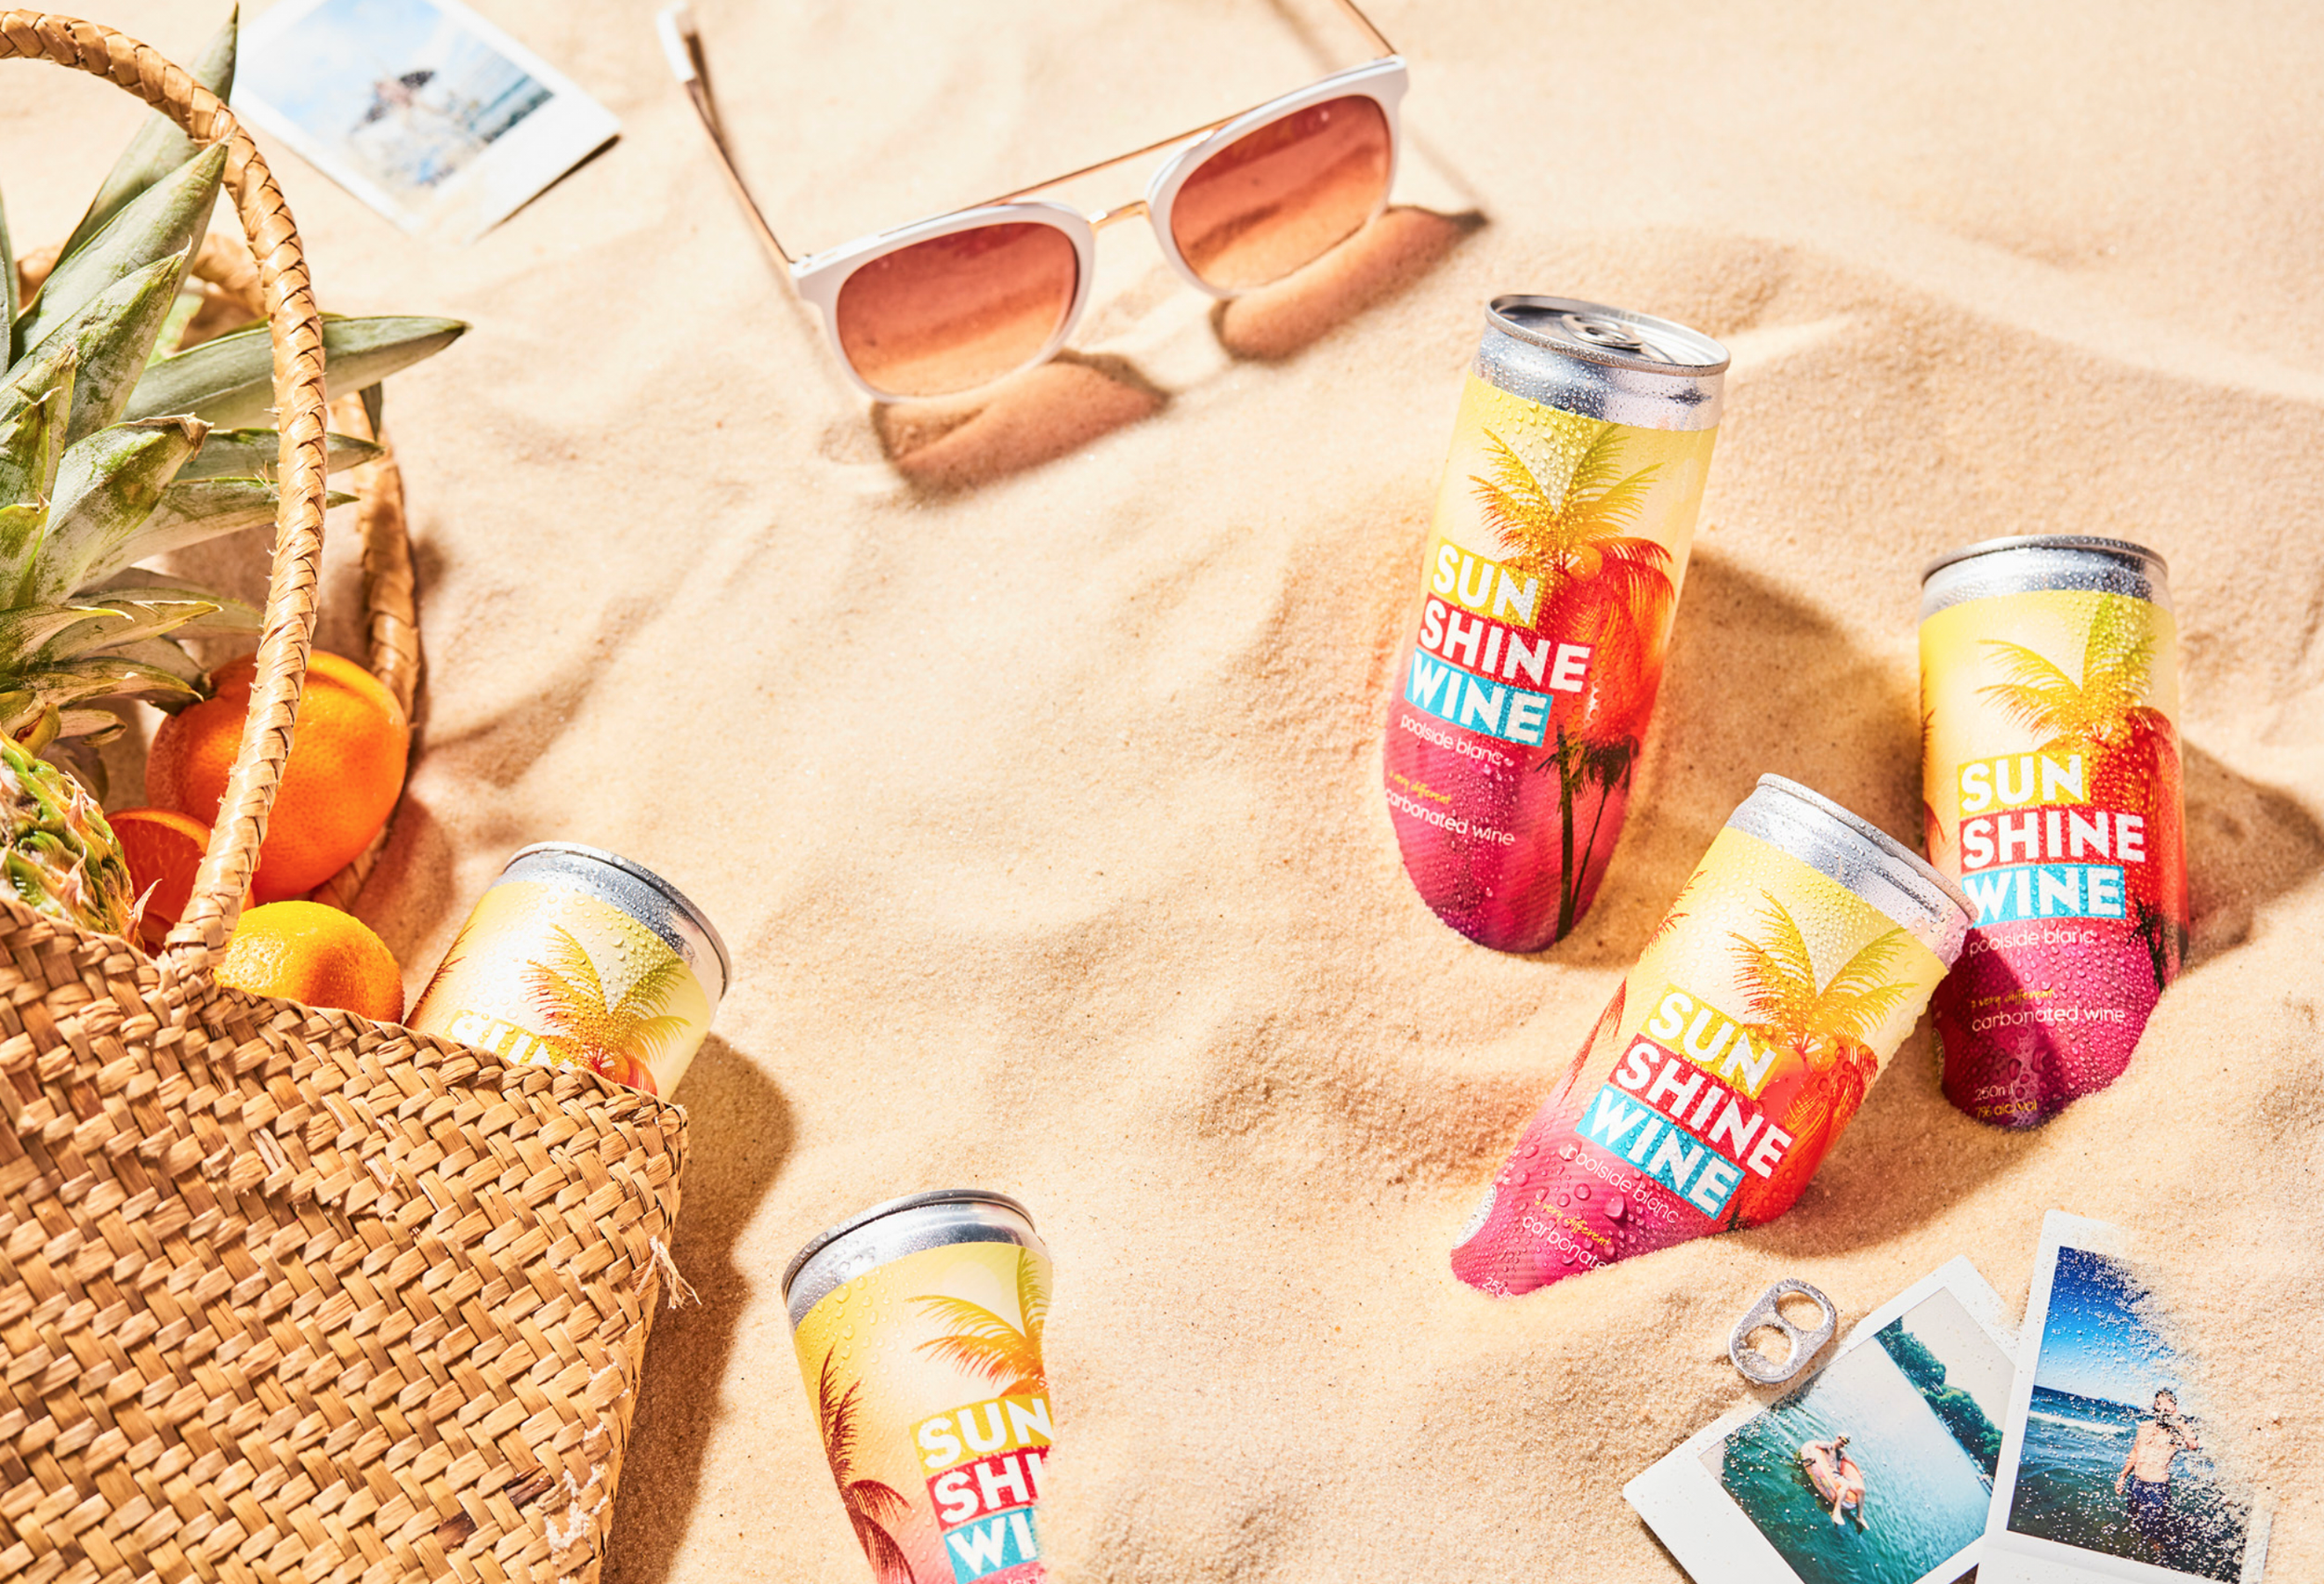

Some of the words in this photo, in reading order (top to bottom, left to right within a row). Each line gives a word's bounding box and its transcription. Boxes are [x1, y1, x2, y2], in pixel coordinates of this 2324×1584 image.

[1433, 545, 1538, 625] SUN
[1420, 600, 1591, 693] SHINE
[1412, 652, 1547, 743] WINE
[1400, 714, 1454, 749] poolside
[1457, 737, 1504, 765] blanc
[1961, 755, 2083, 812] SUN
[1384, 788, 1468, 834] carbonated
[1472, 825, 1514, 845] wine
[1962, 809, 2146, 868] SHINE
[1963, 867, 2121, 923] WINE
[1969, 931, 2040, 957] poolside
[2044, 928, 2094, 944] blanc
[1648, 992, 1777, 1095] SUN
[1972, 1006, 2079, 1032] carbonated
[2083, 1007, 2126, 1023] wine
[1616, 1042, 1792, 1179] SHINE
[1565, 1143, 1631, 1193] poolside
[1632, 1182, 1679, 1223] blanc
[1590, 1089, 1738, 1213] WINE
[1523, 1215, 1607, 1269] carbonate
[1482, 1276, 1512, 1298] 250
[918, 1398, 1054, 1469] SUN
[934, 1453, 1043, 1523] SHI
[946, 1511, 1037, 1576] WI
